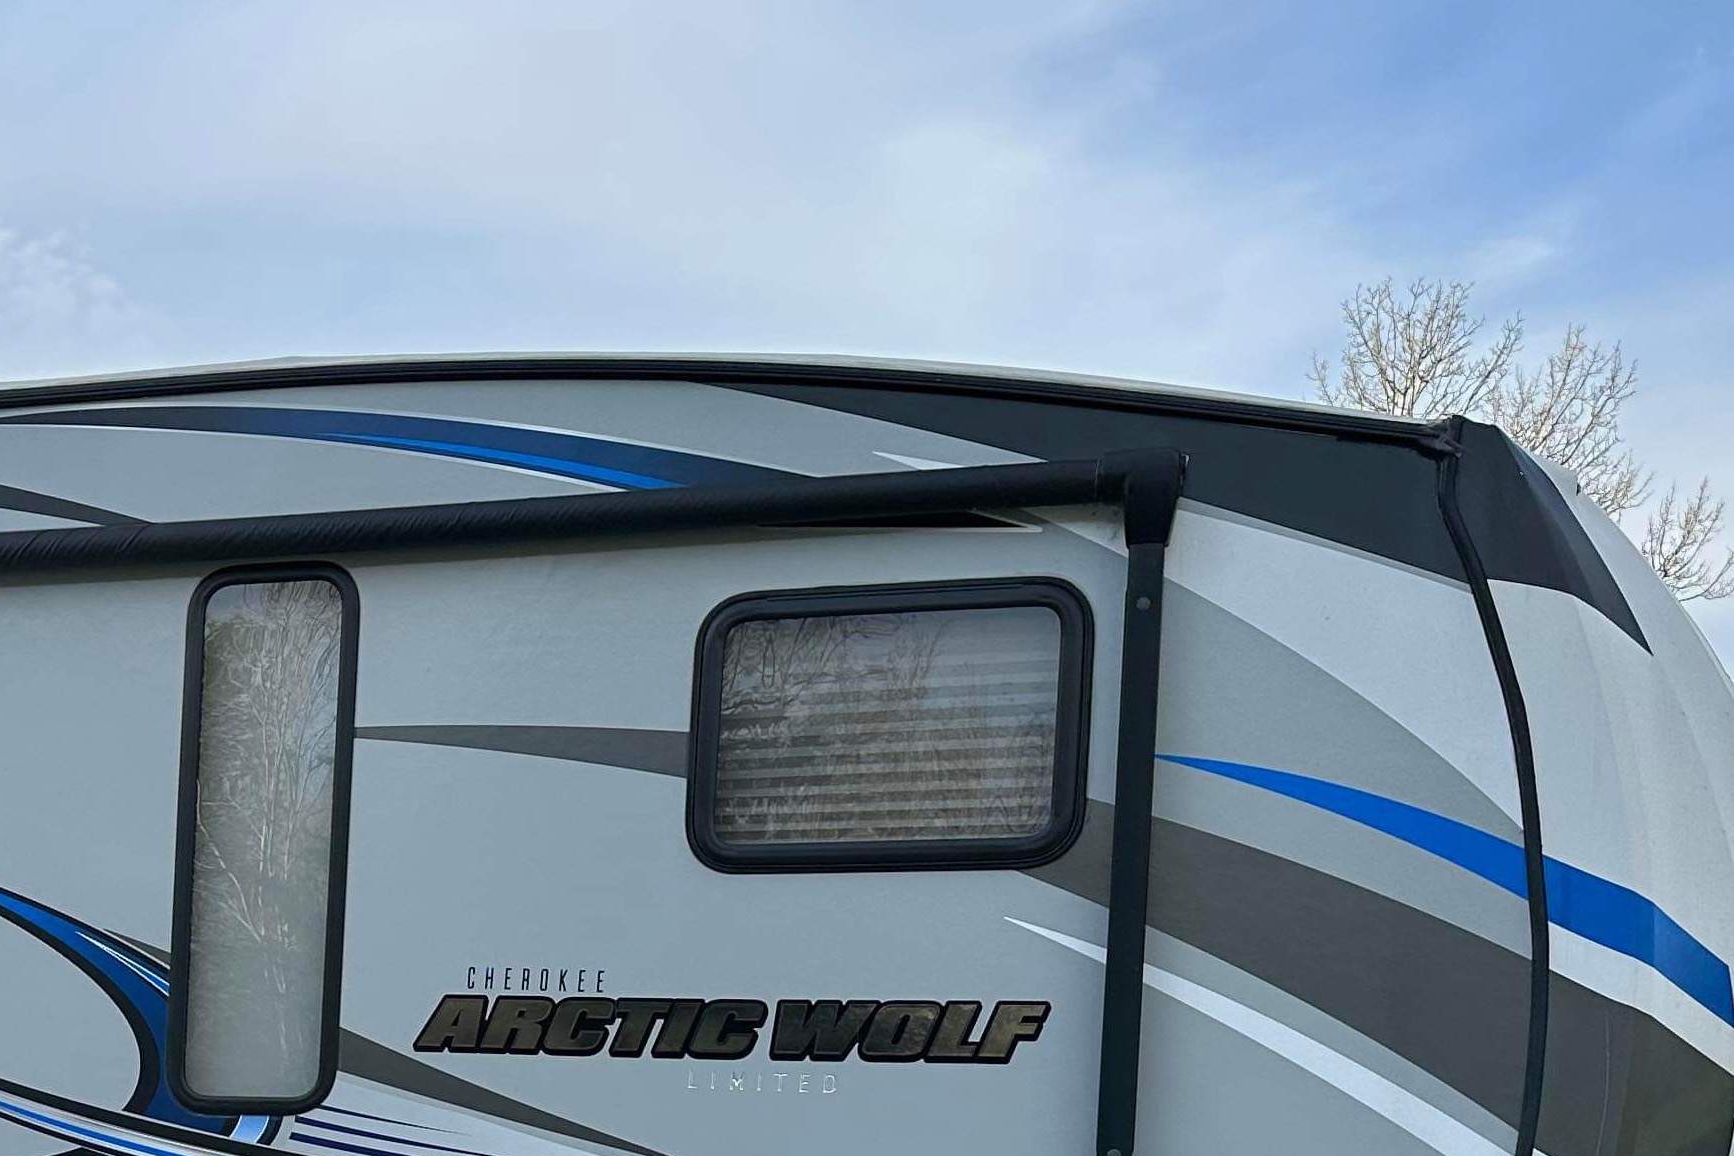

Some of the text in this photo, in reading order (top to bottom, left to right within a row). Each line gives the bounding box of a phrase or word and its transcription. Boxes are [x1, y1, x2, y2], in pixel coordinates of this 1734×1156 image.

[467, 966, 605, 993] CHEROKEE
[413, 994, 1052, 1065] ARCTIC WOLF
[686, 1069, 838, 1094] LIMITED
